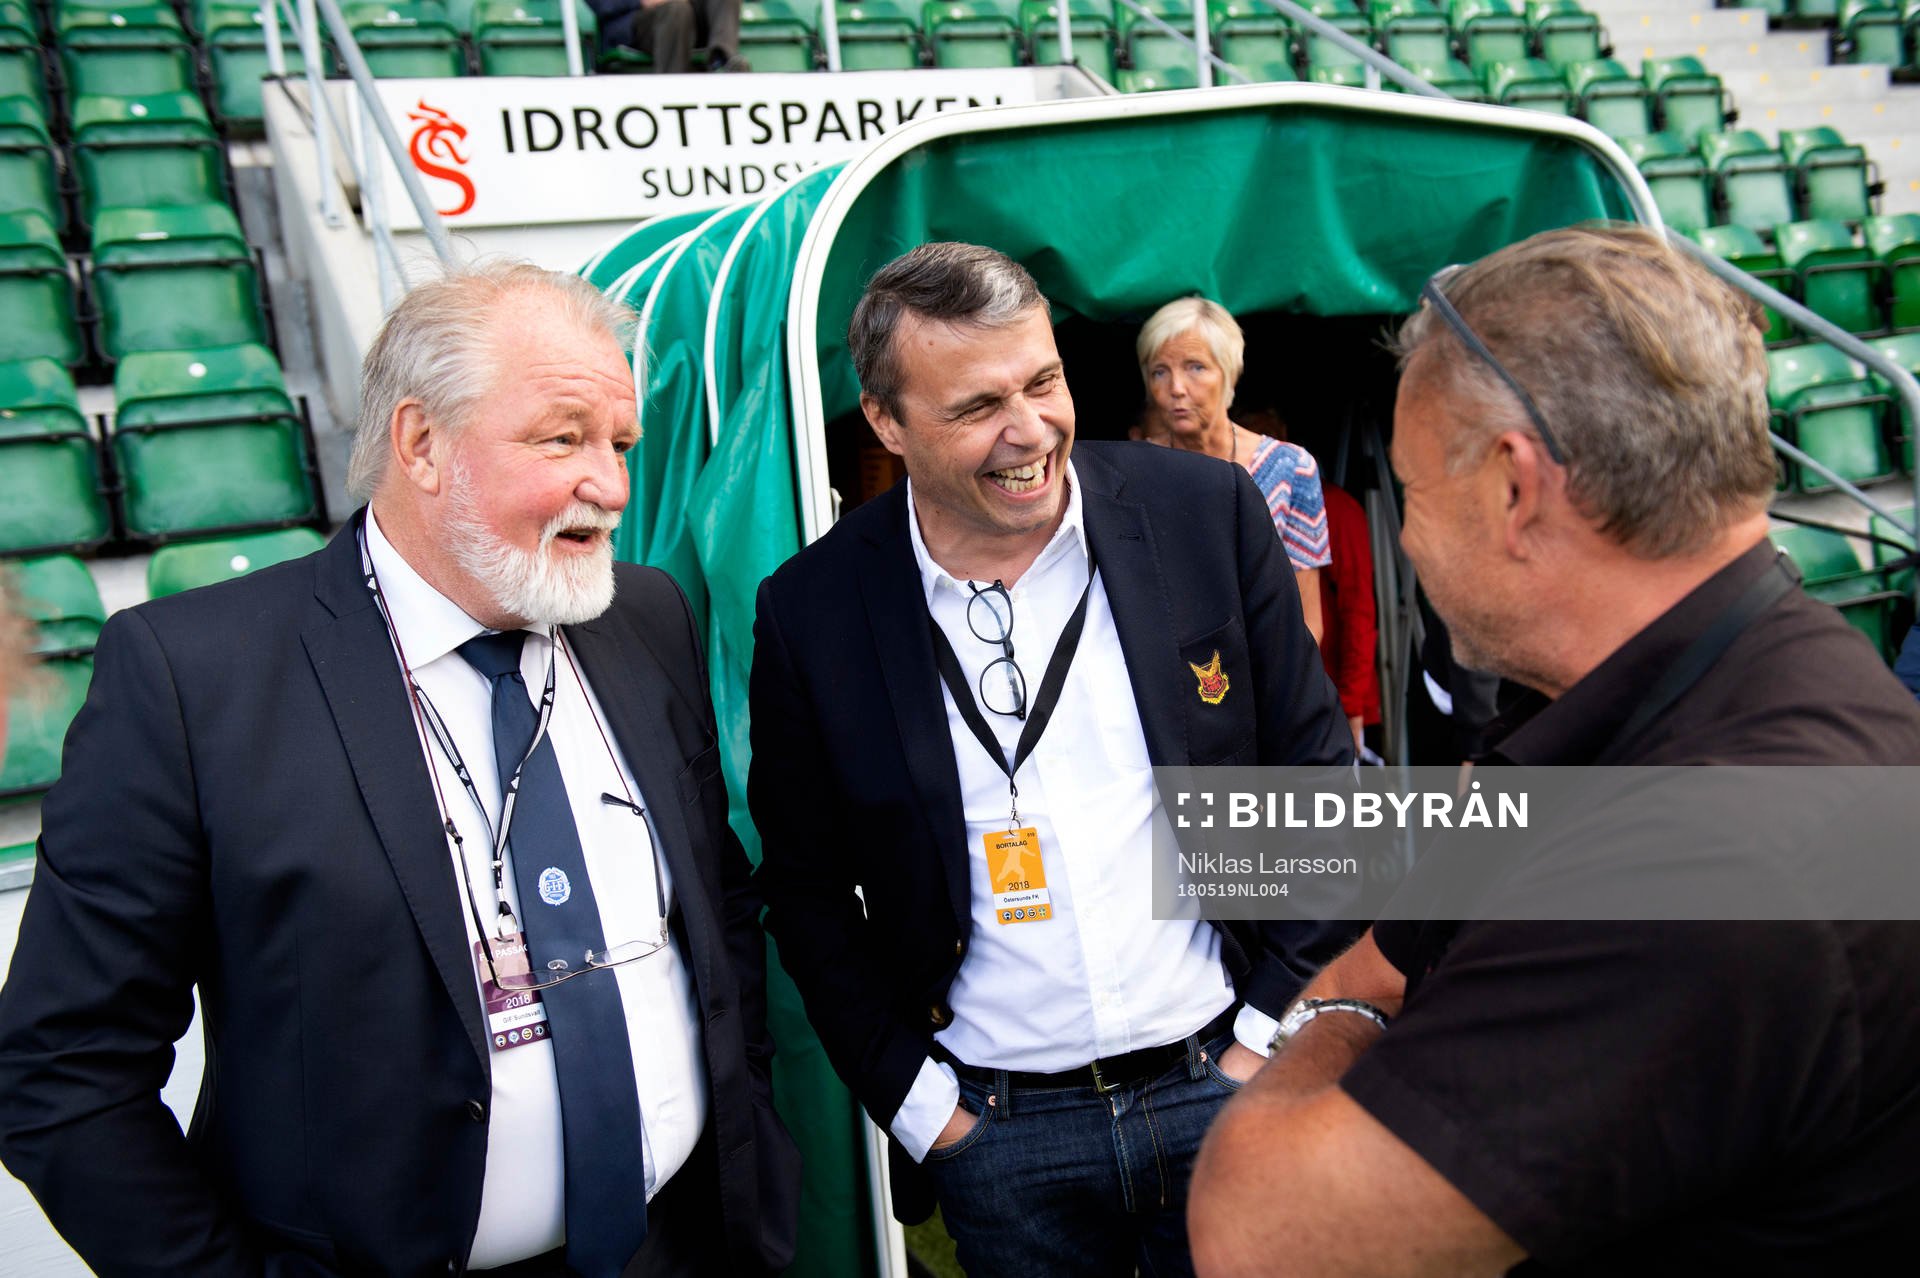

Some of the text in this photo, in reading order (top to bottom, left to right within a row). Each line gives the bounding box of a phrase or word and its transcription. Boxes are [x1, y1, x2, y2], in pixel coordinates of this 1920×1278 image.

[642, 160, 819, 199] SUNDS
[996, 840, 1028, 849] BORTALAG
[1008, 880, 1030, 891] 2018
[505, 994, 531, 1008] 2018
